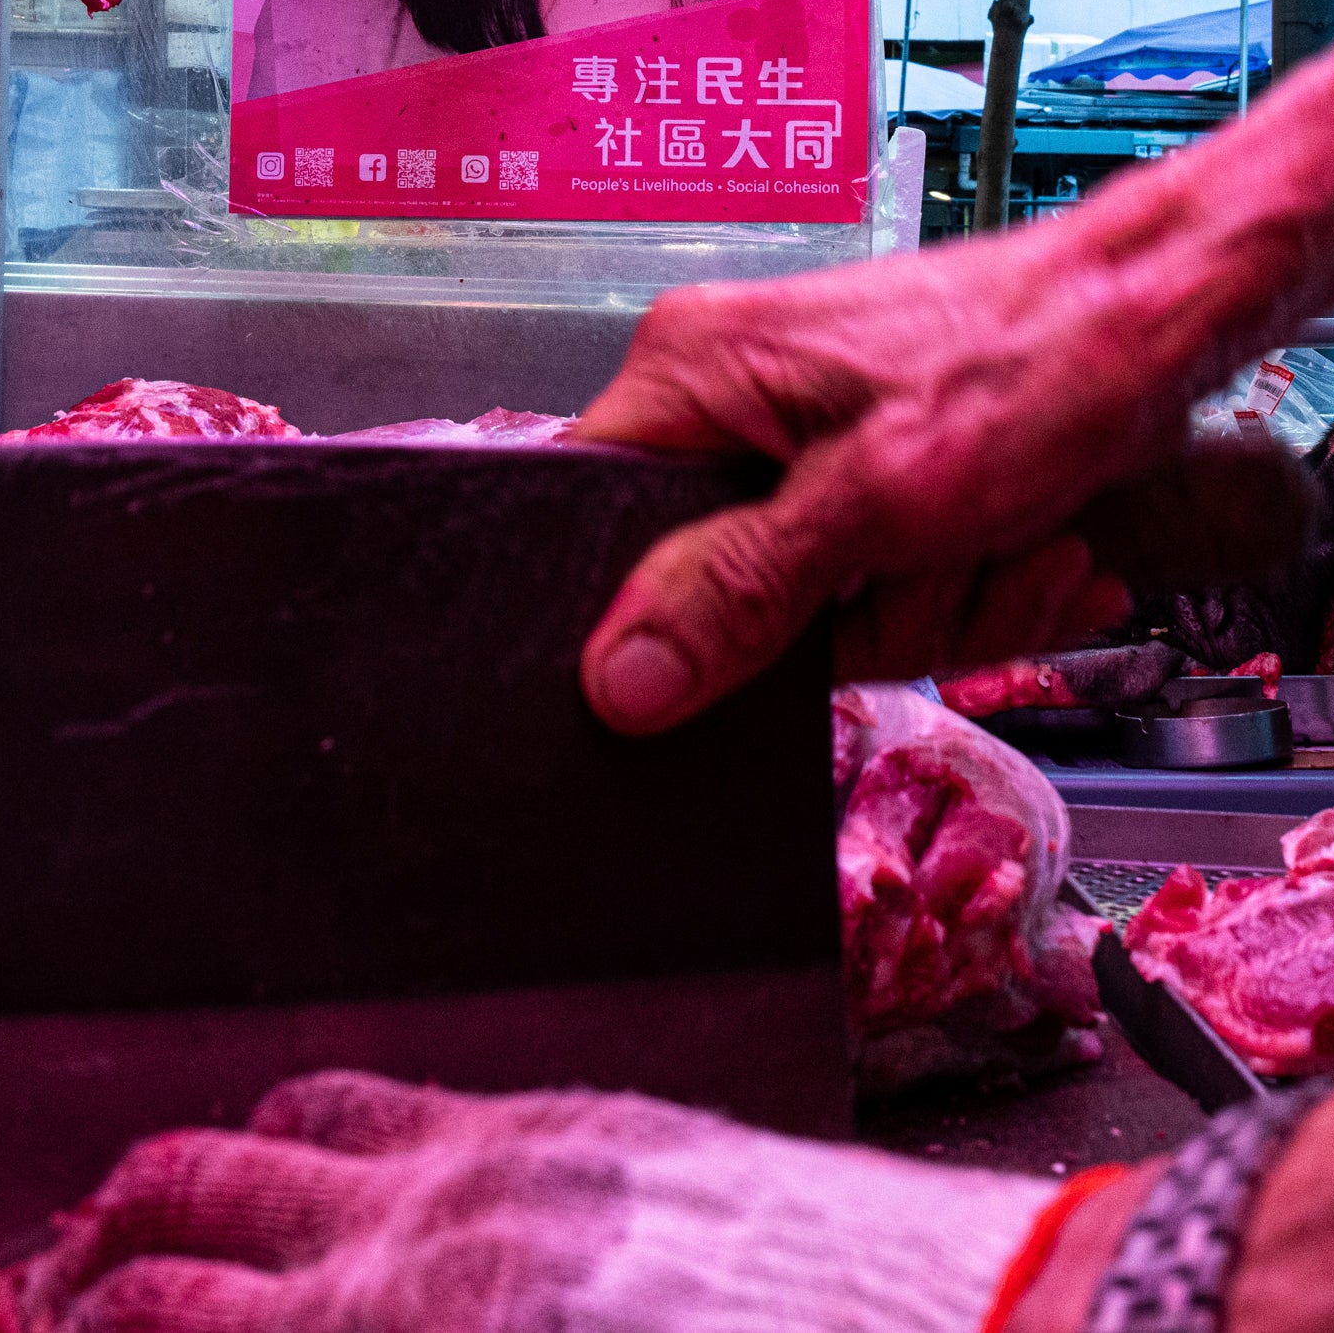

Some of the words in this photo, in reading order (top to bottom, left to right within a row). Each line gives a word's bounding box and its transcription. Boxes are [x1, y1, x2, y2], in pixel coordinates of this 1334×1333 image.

[571, 55, 805, 106] 專注民生
[593, 117, 834, 170] 社區大同
[571, 177, 630, 194] People's
[633, 177, 715, 194] Livelihoods
[726, 179, 770, 194] Social
[773, 179, 841, 195] Cohesion
